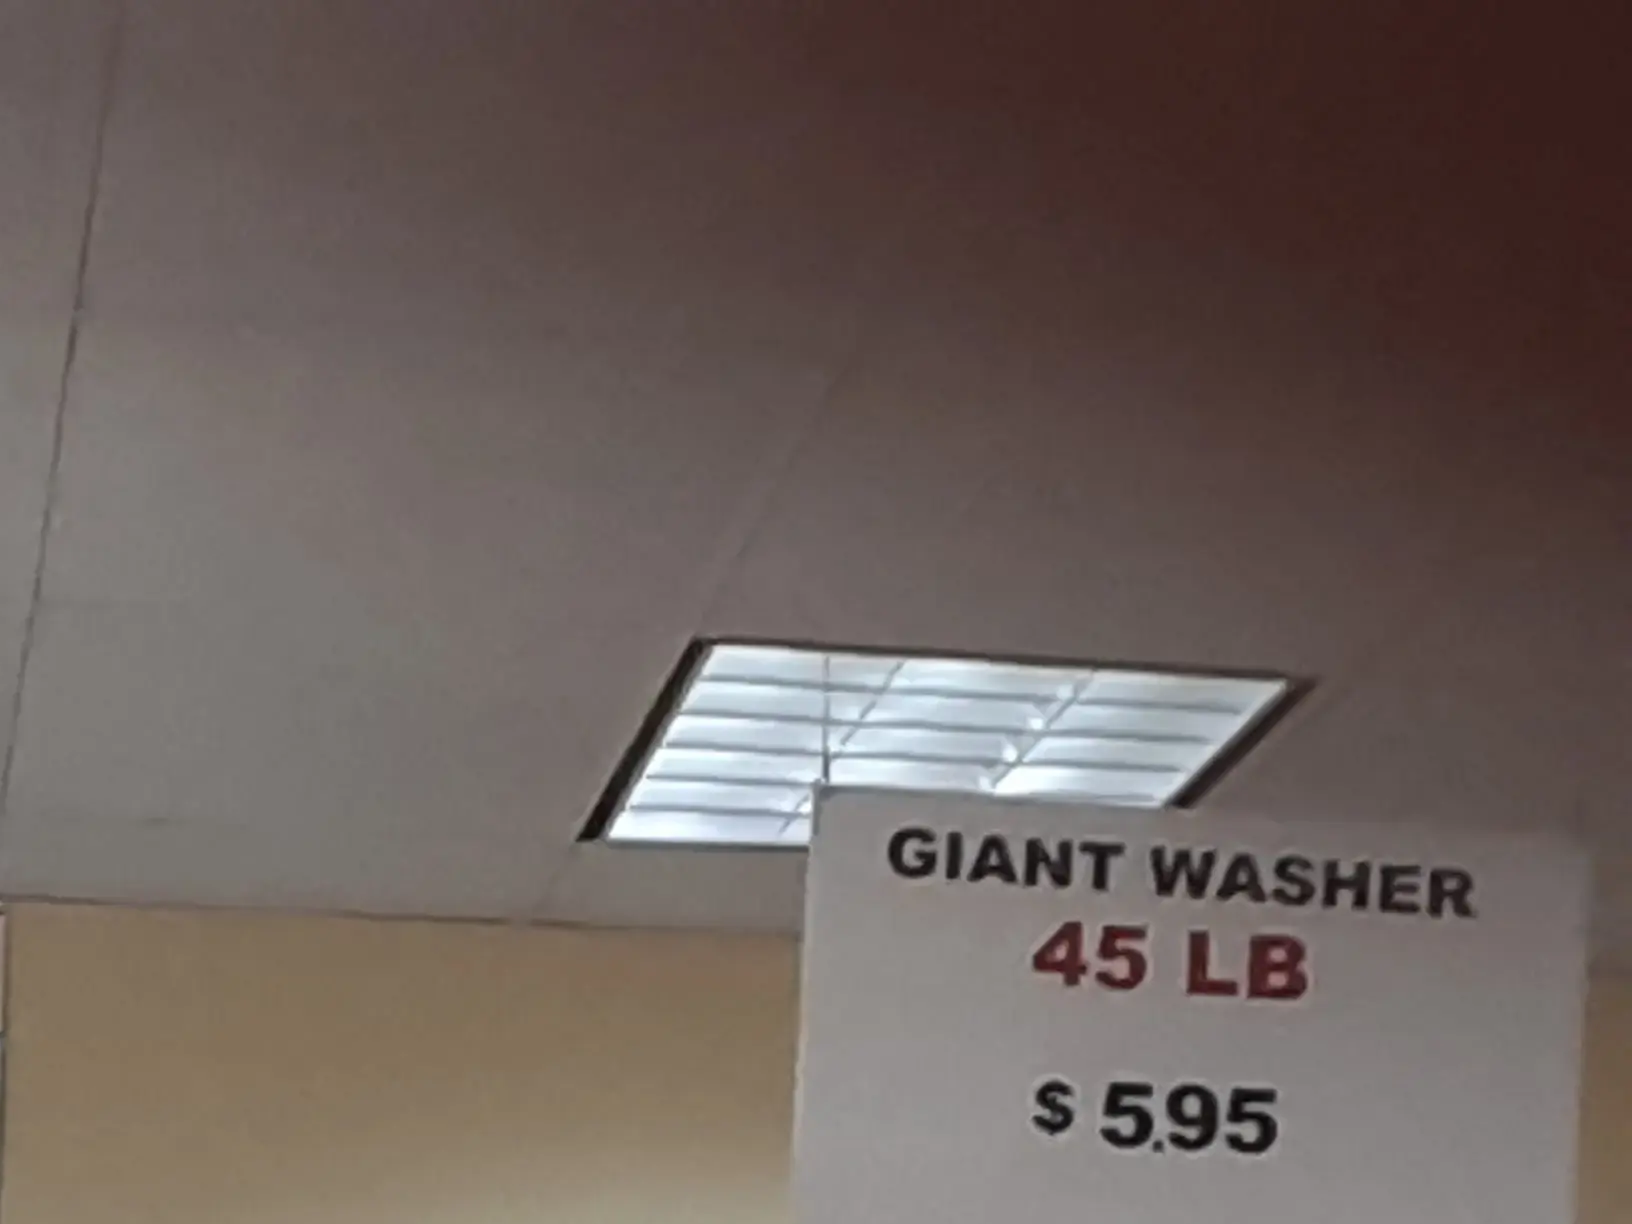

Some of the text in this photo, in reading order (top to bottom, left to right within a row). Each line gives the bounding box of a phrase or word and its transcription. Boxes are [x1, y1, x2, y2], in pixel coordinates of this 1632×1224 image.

[887, 827, 1477, 919] GIANT WASHER
[1031, 920, 1310, 1001] 45 LB
[1100, 1082, 1279, 1154] 5.95
